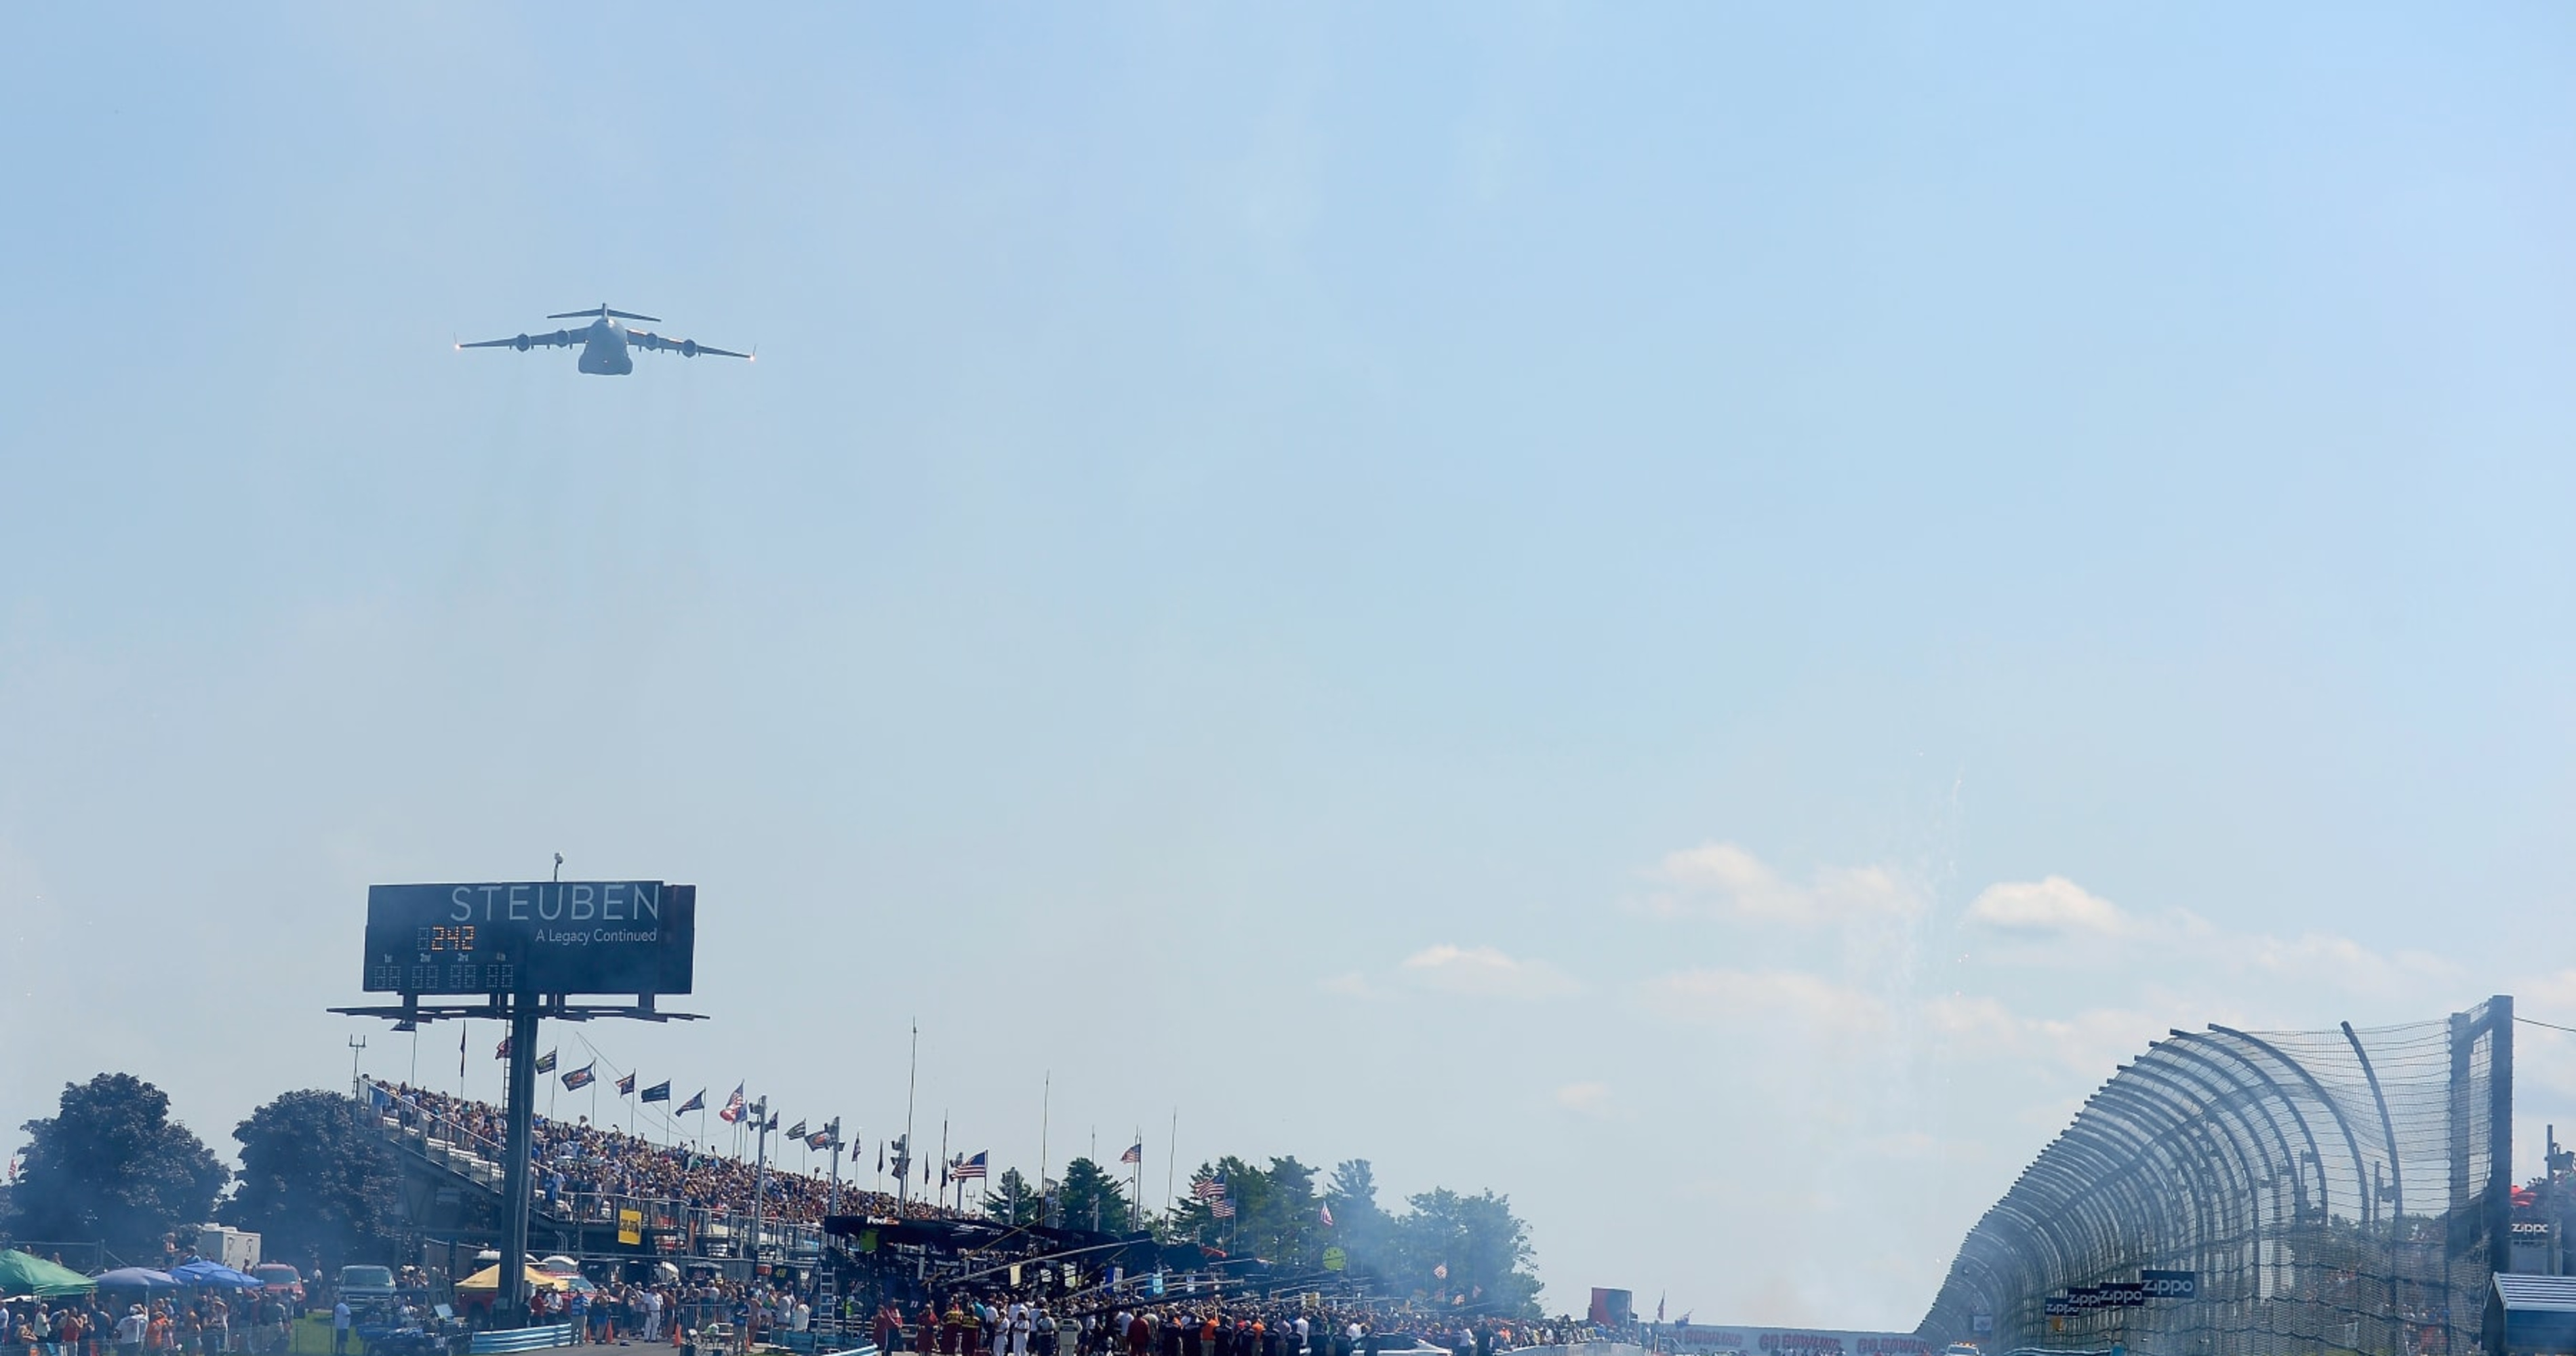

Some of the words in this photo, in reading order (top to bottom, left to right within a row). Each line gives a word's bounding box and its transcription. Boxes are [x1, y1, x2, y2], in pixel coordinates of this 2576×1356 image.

[450, 883, 660, 921] STEUBEN
[432, 925, 475, 951] 242
[535, 929, 546, 942] A
[549, 929, 590, 946] Legacy
[593, 928, 657, 942] Continued
